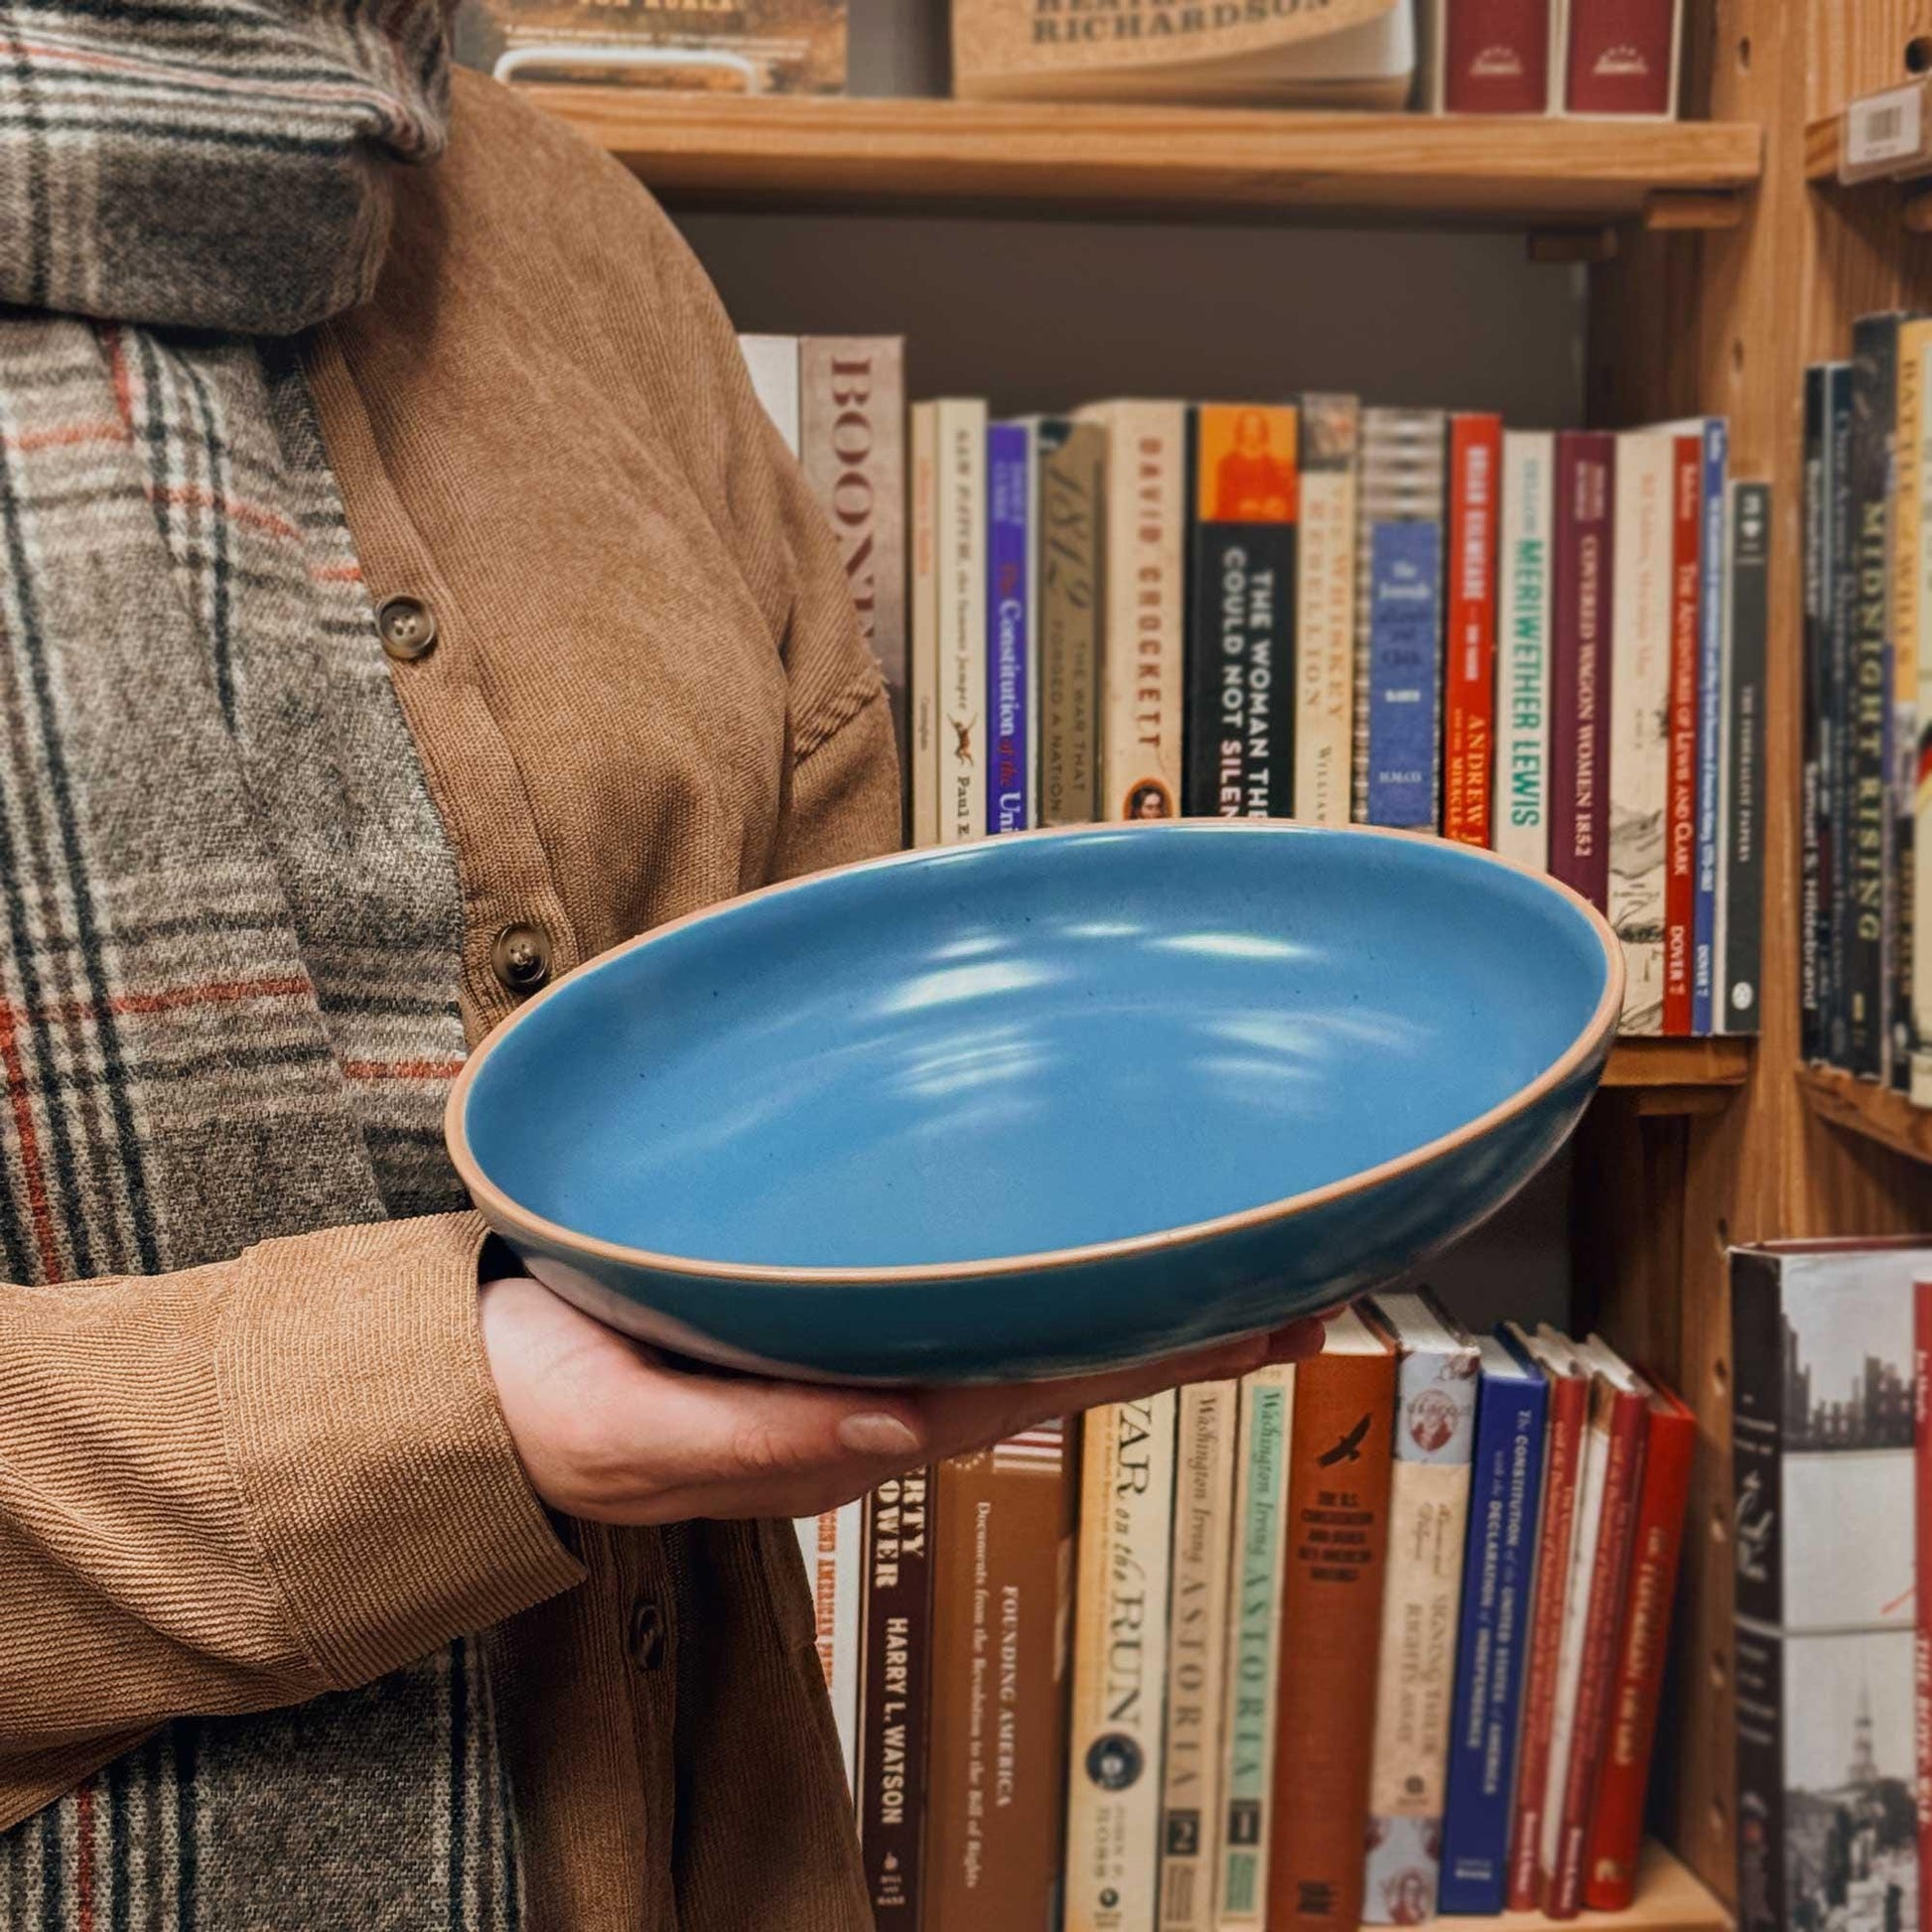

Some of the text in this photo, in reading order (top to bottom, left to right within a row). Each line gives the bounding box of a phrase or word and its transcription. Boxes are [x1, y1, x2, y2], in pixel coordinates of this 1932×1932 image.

[1136, 437, 1163, 749] DAVID CROCKETT
[1222, 546, 1246, 655] COULD
[1250, 570, 1274, 629] THE
[1513, 538, 1546, 740] MERIWETHER
[1579, 536, 1596, 638] COVERED
[999, 599, 1023, 736] Constitution
[1049, 713, 1062, 727] A
[1072, 641, 1086, 792] THE WAR THAT
[1221, 664, 1243, 729] NOT
[1249, 638, 1271, 758] WOMAN
[1577, 643, 1595, 716] WAGON
[1857, 497, 1885, 942] MIDNIGHT RISING
[956, 776, 971, 821] Paul
[1048, 735, 1062, 811] NATION
[1450, 758, 1462, 826] MIRACLE
[1465, 714, 1486, 826] ANDREW
[1511, 740, 1542, 827] LEWIS
[1575, 725, 1594, 807] WOMEN
[1575, 812, 1592, 857] 1852
[1803, 761, 1819, 1011] Samuel S. Hildebrand
[1670, 926, 1685, 980] DOVER
[1115, 1507, 1132, 1535] on
[1507, 1436, 1528, 1546] CONSTITUTION
[1113, 1543, 1148, 1583] the
[1172, 1396, 1218, 1788] Washington Irving ASTORIA
[1236, 1392, 1282, 1779] Washington Irving ASTORIA
[1480, 1500, 1503, 1607] DECLARATION
[1106, 1590, 1147, 1728] RUN
[1496, 1587, 1515, 1641] UNITED
[1917, 1639, 1931, 1684] THE
[880, 1617, 909, 1825] HARRY L. WATSON
[964, 1501, 992, 1889] Documents from the Revolution to the Bill of Rights
[995, 1586, 1020, 1808] FOUNDING AMERICA
[1466, 1628, 1490, 1749] INDEPENDENCE
[1483, 1723, 1502, 1795] AMERICA
